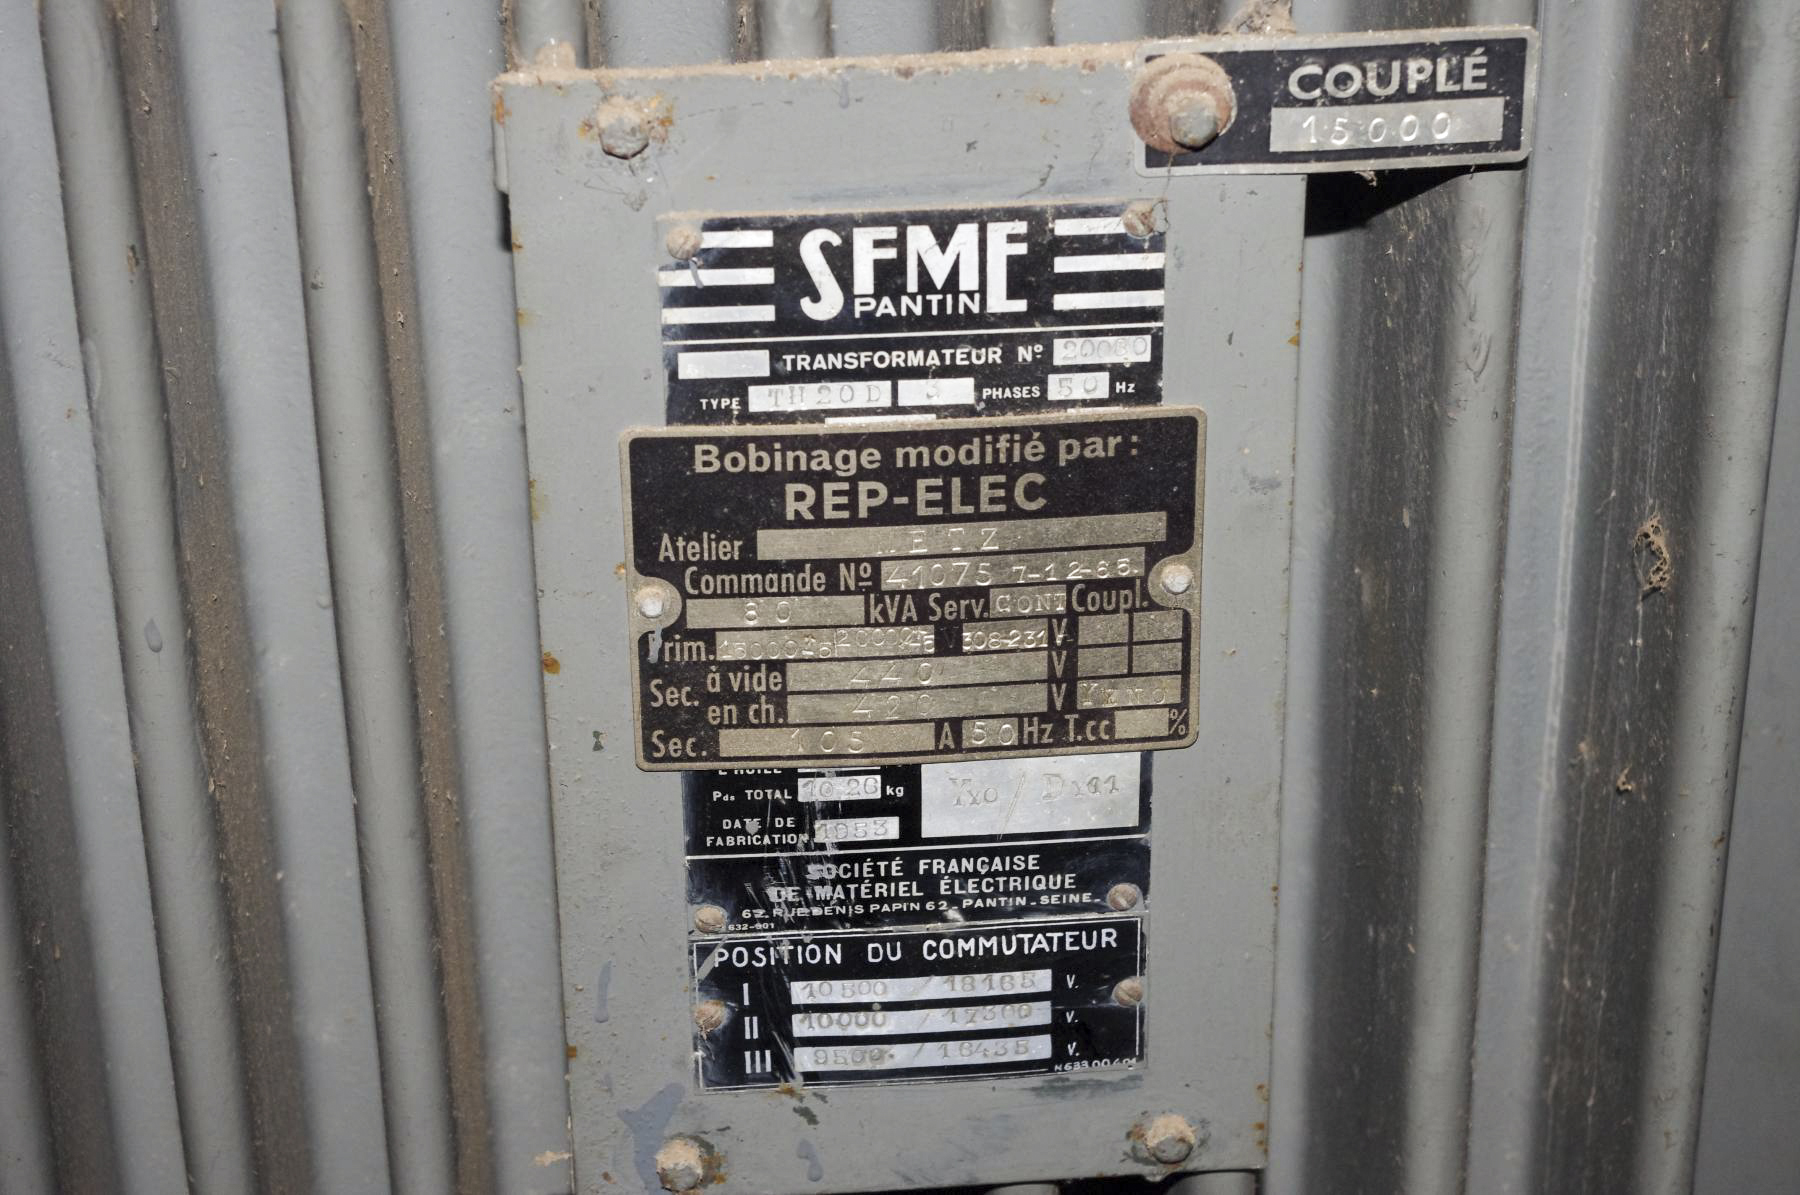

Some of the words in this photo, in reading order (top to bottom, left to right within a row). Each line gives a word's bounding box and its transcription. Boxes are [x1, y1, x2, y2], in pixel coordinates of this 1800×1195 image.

[1287, 47, 1489, 100] COUPLÉ
[1302, 112, 1452, 145] 15000
[799, 221, 1029, 321] SFME
[854, 292, 981, 318] PANTIN
[783, 346, 1003, 372] TRANSFORMATEUR
[700, 398, 742, 411] TYPE
[982, 387, 1041, 402] PHASES
[1057, 375, 1099, 398] 50
[1115, 381, 1136, 394] Hz
[693, 443, 882, 477] Bobinage
[896, 431, 1045, 469] modifié
[785, 472, 1048, 521] REP-ELEC
[658, 532, 743, 562] Atelier
[684, 562, 826, 595] Commande
[886, 561, 994, 591] 41075
[744, 600, 793, 626] 80
[869, 593, 919, 624] kVA
[928, 592, 990, 622] Serv.
[996, 592, 1067, 614] CONT
[1071, 578, 1149, 614] Coupl.
[1051, 617, 1068, 648] V
[706, 664, 722, 694] à
[729, 662, 783, 692] vide
[1051, 650, 1068, 679] V
[649, 679, 700, 709] Sec.
[706, 702, 738, 727] en
[748, 694, 784, 725] ch.
[1051, 682, 1068, 712] V
[650, 729, 708, 759] Sec.
[789, 729, 865, 754] 105
[937, 722, 956, 751] A
[970, 721, 1016, 747] 50
[1023, 716, 1054, 744] Hz
[1168, 707, 1189, 736] %
[712, 790, 737, 804] Pds
[744, 788, 793, 802] TOTAL
[886, 784, 905, 798] kg
[706, 832, 811, 848] FABRICATION
[722, 818, 762, 831] DATE
[774, 817, 796, 828] DE
[804, 855, 904, 880] SOCIÉTÉ
[918, 854, 1041, 876] FRANÇAISE
[766, 886, 801, 902] DE
[814, 878, 925, 901] MATÉRIEL
[939, 873, 1077, 897] ÉLECTRIQUE
[810, 904, 865, 917] DENIS
[869, 901, 921, 914] PAPIN
[961, 897, 1029, 909] PANTIN
[713, 943, 843, 968] POSITION
[867, 941, 903, 963] DU
[922, 927, 1118, 961] COMMUTATEUR
[1066, 974, 1080, 990] V.
[1065, 1009, 1080, 1025] V.
[744, 1049, 773, 1075] III
[1067, 1041, 1081, 1058] V.
